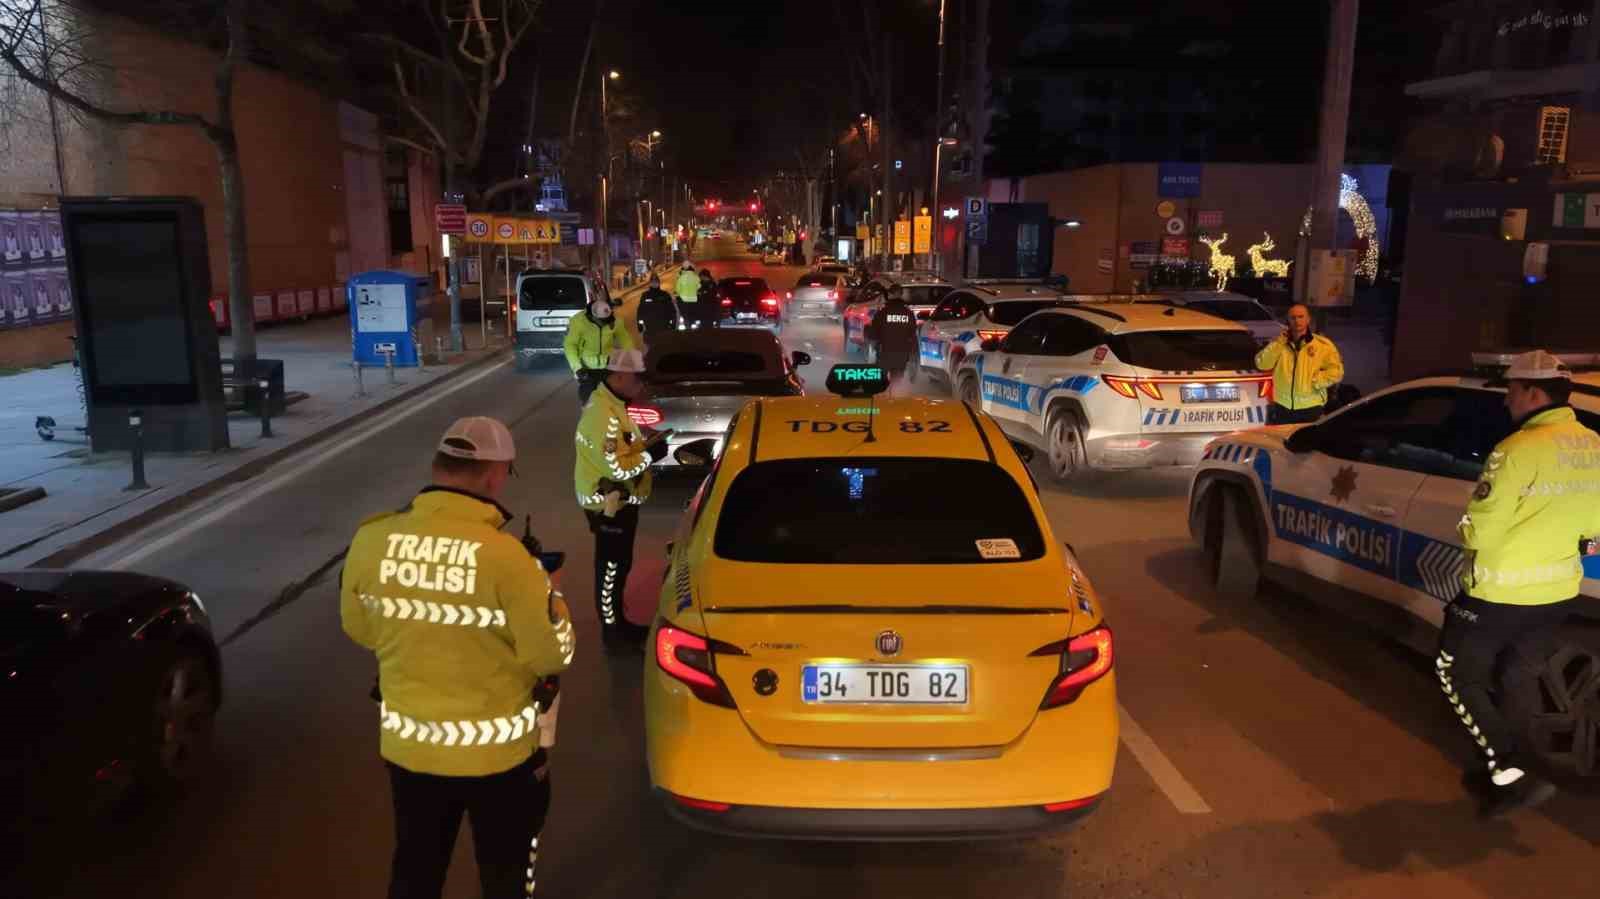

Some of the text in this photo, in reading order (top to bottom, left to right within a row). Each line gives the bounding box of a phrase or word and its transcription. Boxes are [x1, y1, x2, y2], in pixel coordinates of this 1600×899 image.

[473, 223, 486, 231] 30
[785, 420, 953, 433] TDG 82
[819, 671, 958, 698] 34 TDG 82
[806, 686, 817, 694] TR
